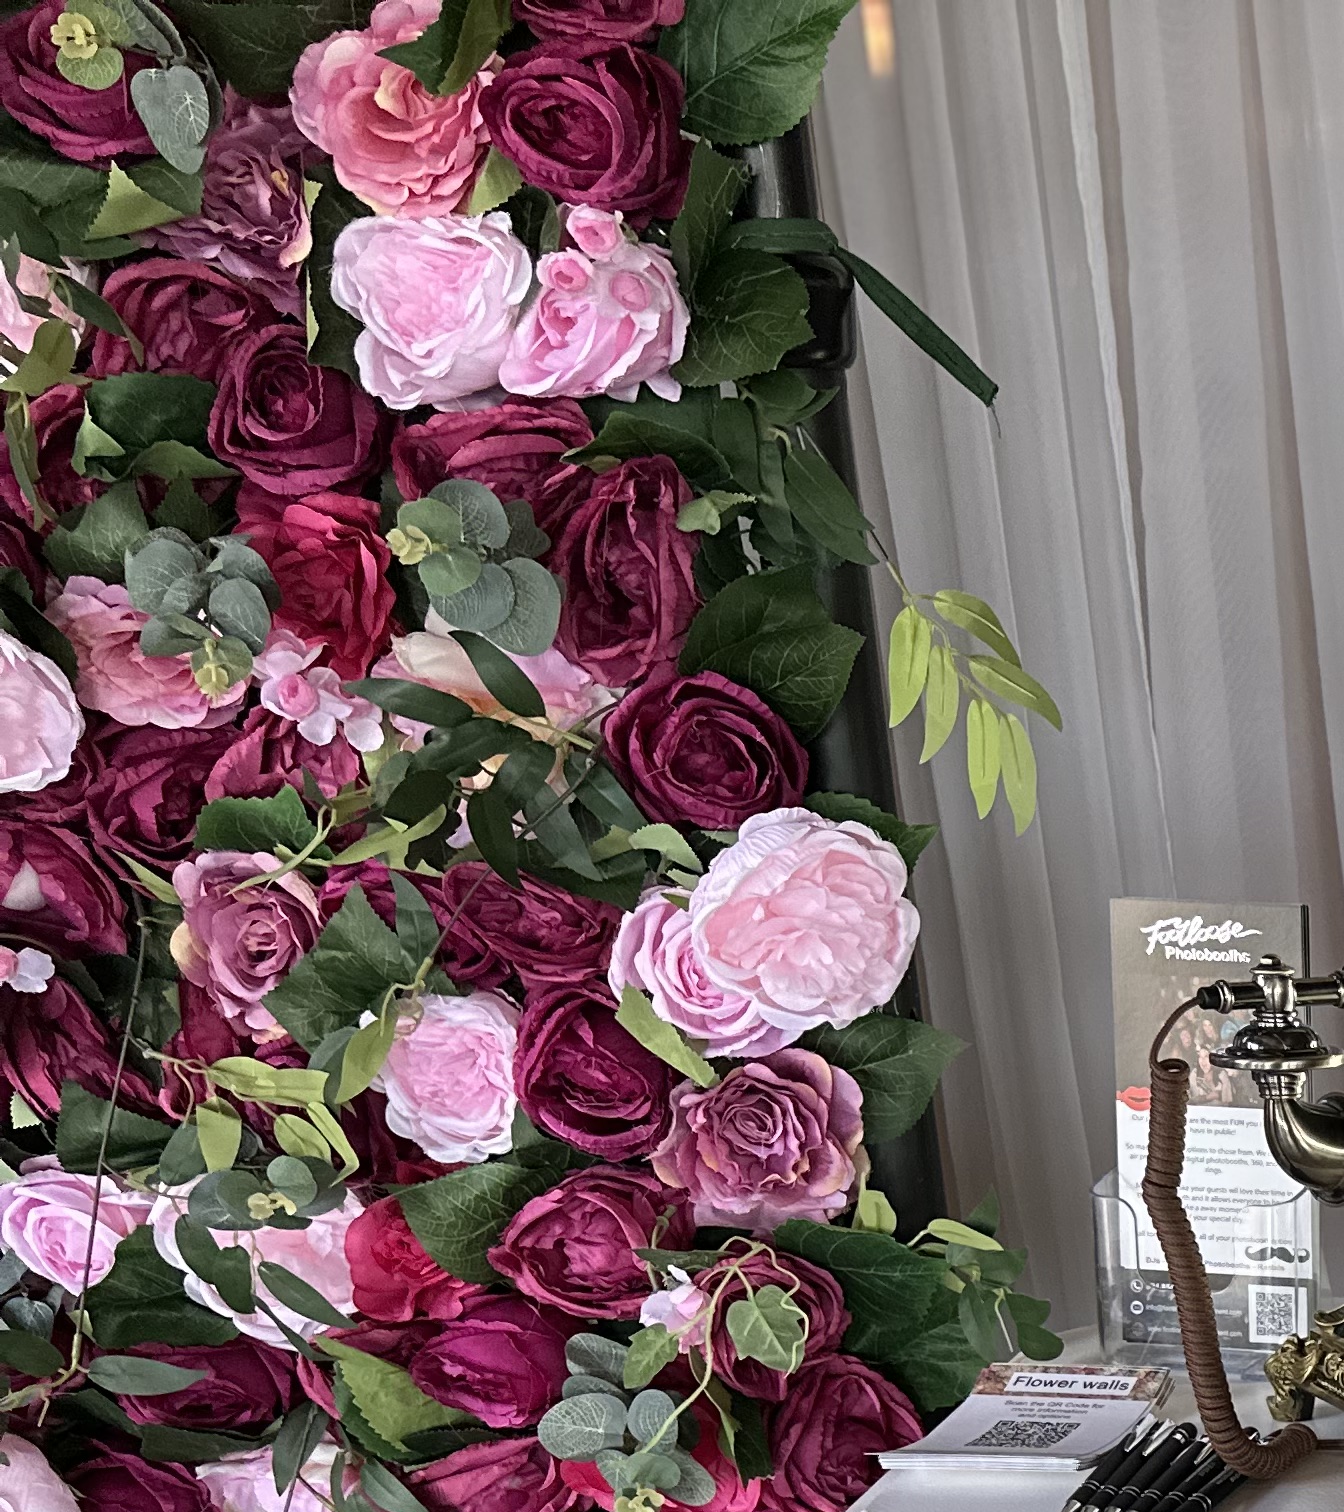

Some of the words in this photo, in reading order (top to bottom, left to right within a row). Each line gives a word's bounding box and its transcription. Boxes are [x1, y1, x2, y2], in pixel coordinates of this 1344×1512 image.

[1139, 915, 1263, 955] Footloose
[1165, 945, 1252, 963] Photobooths
[1229, 1119, 1245, 1127] FUN
[1012, 1376, 1078, 1389] Flower
[1083, 1379, 1130, 1391] walls
